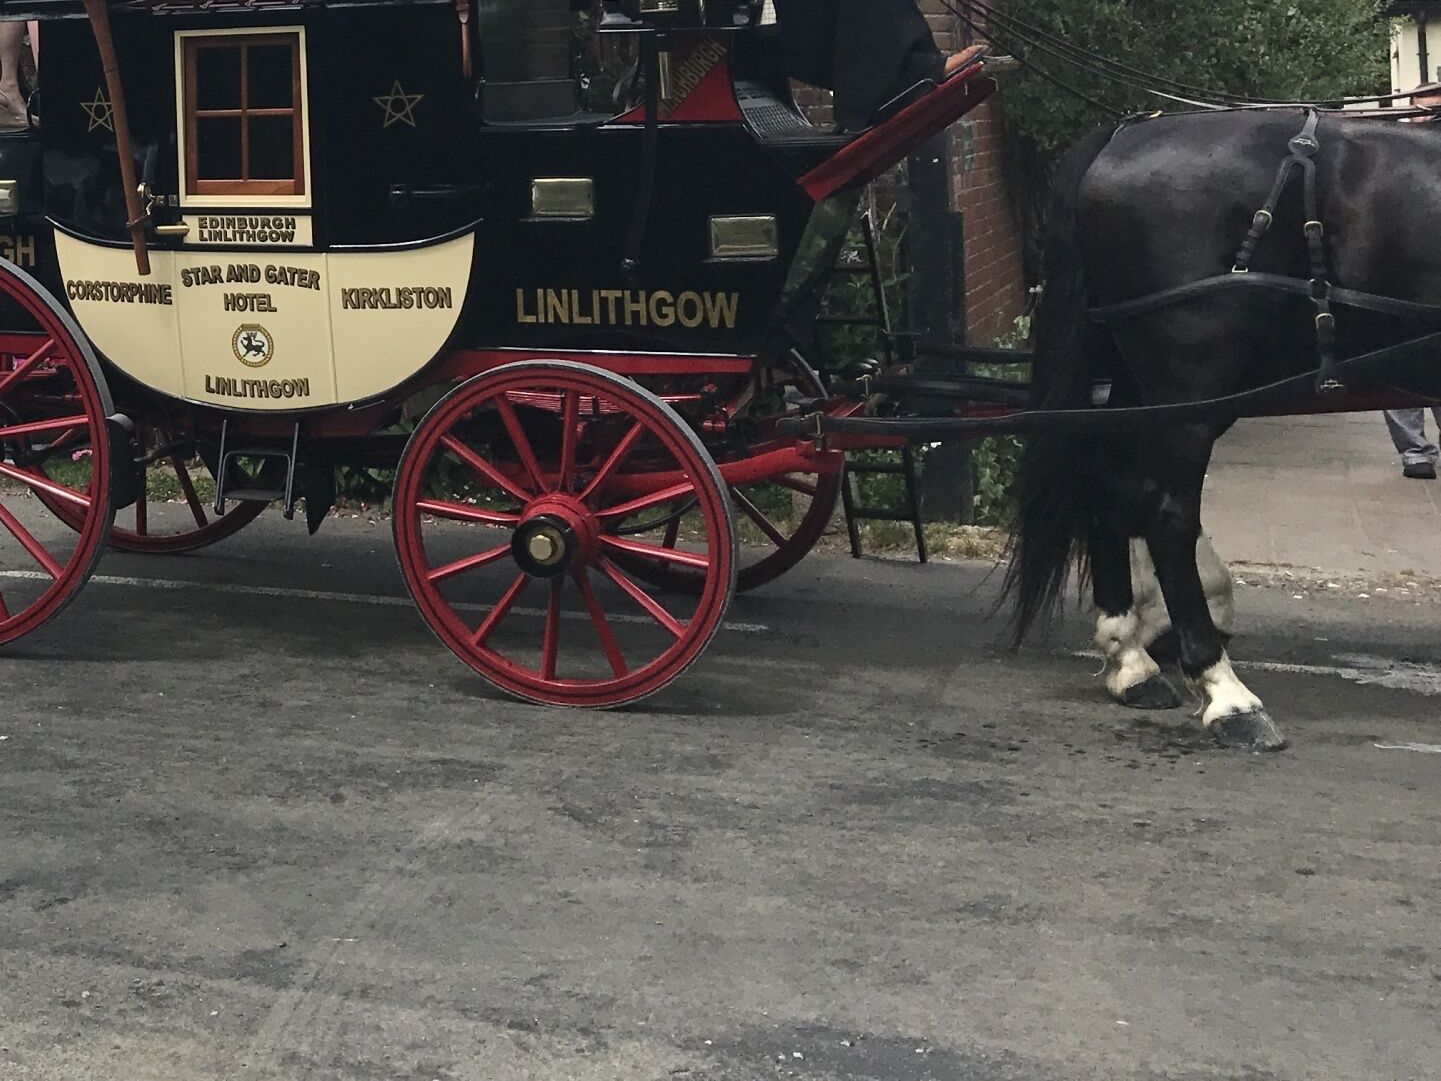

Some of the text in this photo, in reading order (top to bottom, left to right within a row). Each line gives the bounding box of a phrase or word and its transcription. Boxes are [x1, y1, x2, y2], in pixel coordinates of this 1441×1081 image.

[197, 216, 297, 231] EDINBURGH
[198, 229, 296, 244] LINLITHGOW
[180, 263, 321, 291] STAR AND GATER
[66, 279, 173, 306] CORSTORPHINE
[223, 292, 277, 313] HOTEL
[341, 285, 453, 310] KIRKLISTON
[516, 288, 739, 329] LINLITHGOW
[204, 374, 310, 399] LINLITHGOW
